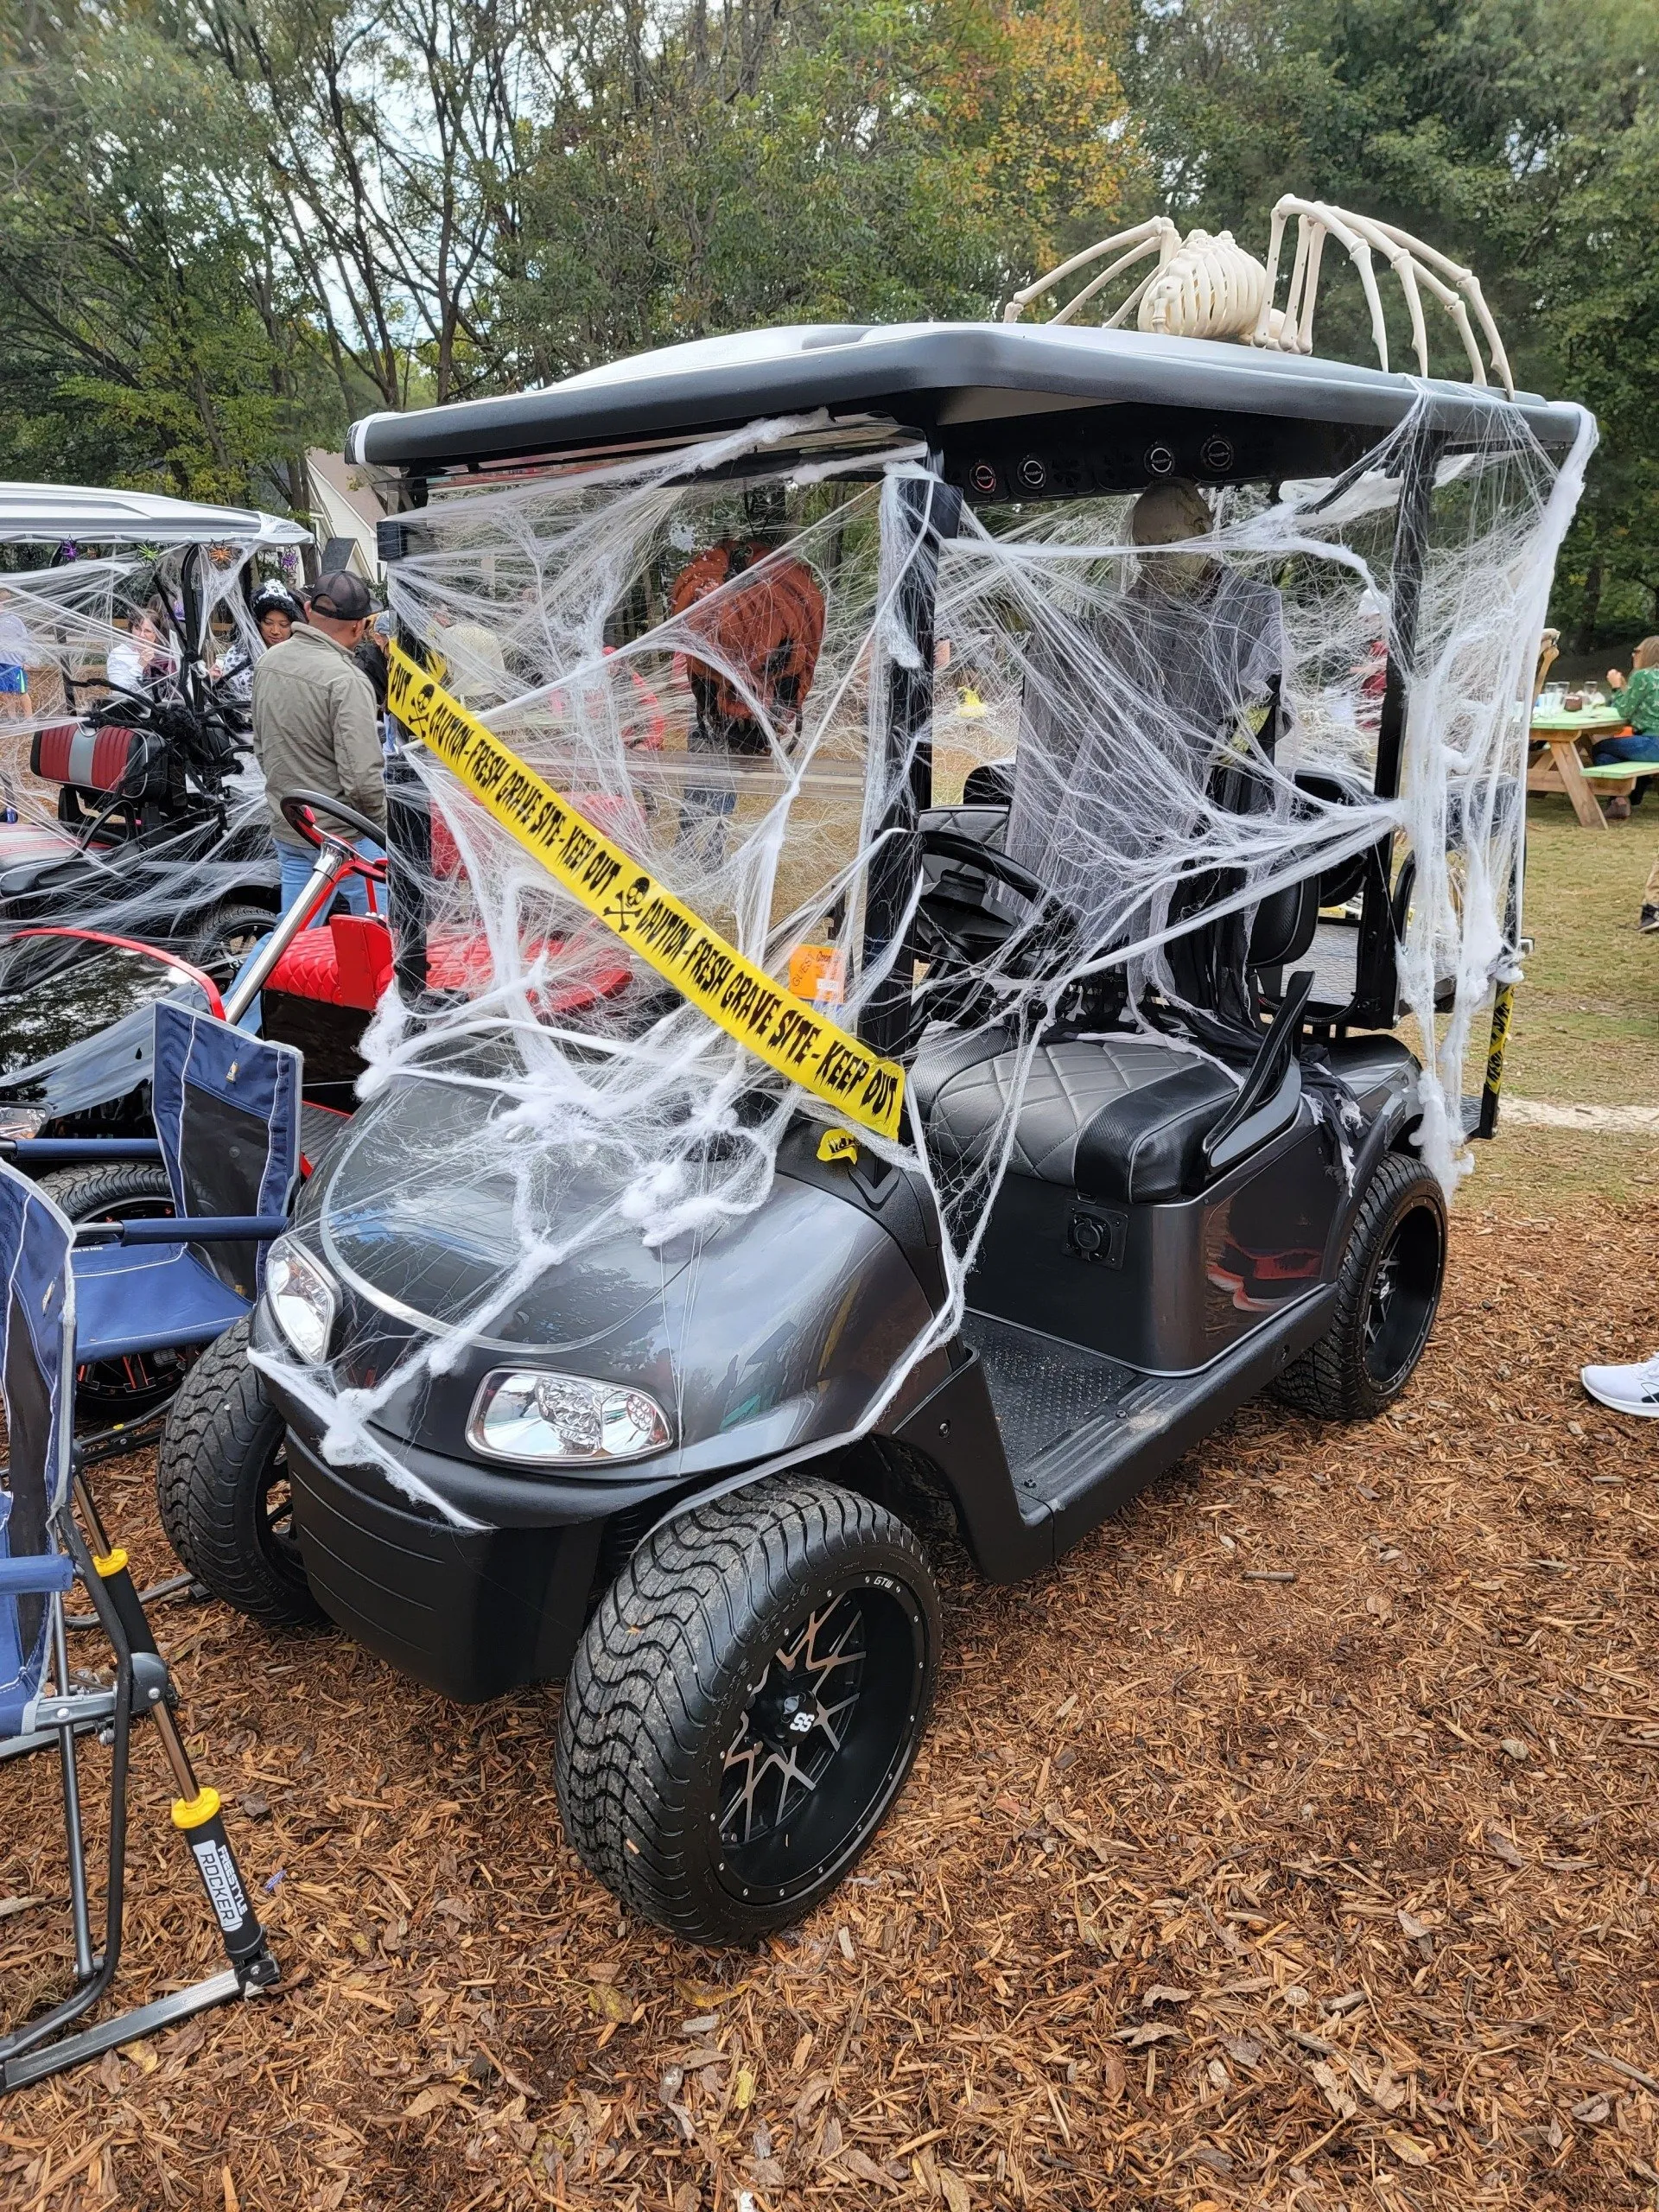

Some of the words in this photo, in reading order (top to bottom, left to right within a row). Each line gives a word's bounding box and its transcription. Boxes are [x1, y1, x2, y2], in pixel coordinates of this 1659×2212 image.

[390, 663, 413, 710] OUT
[495, 769, 543, 825] GRAVE
[580, 850, 623, 899] OUT
[720, 969, 784, 1040] GRAVE
[858, 1068, 899, 1126] OUT
[874, 1576, 894, 1589] GTW
[790, 1713, 816, 1732] SS
[200, 1853, 235, 1923] ROCKER
[218, 1844, 249, 1916] FREESTYLE
